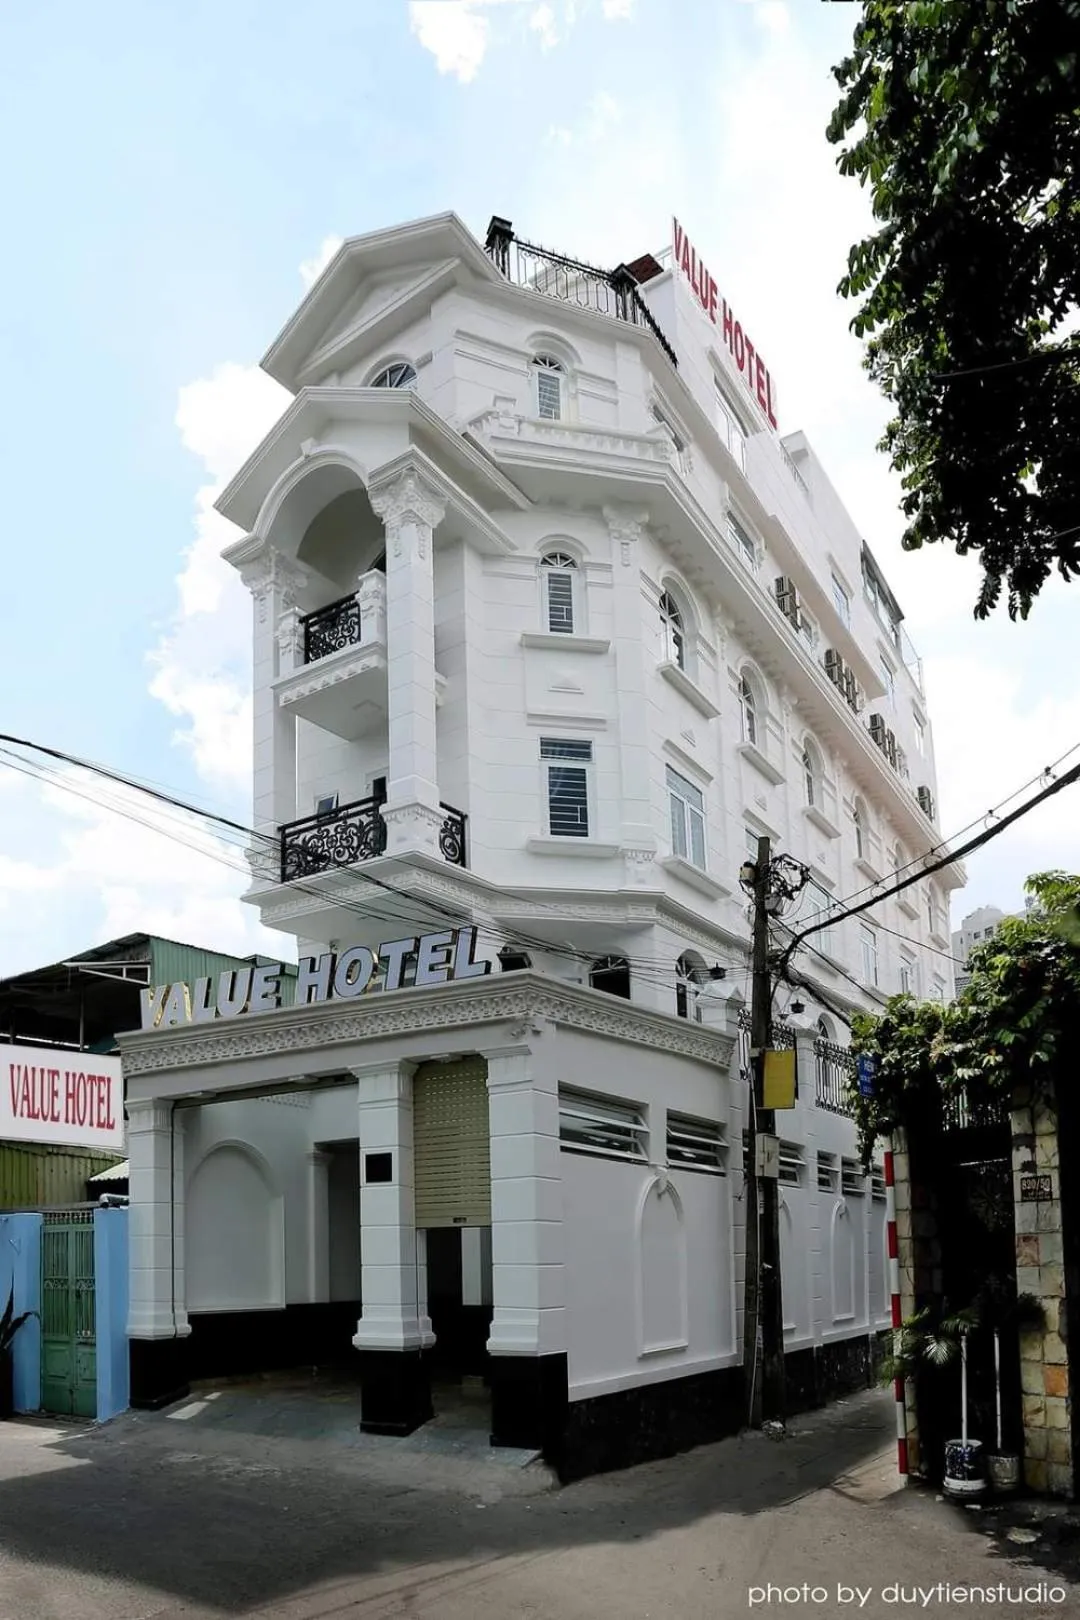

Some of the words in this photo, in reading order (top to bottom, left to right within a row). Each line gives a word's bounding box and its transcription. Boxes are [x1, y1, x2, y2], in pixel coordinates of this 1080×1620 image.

[672, 215, 718, 325] VALUE
[722, 297, 777, 431] HOTEL
[139, 963, 285, 1030] VALUE
[299, 925, 492, 1004] HOTEL
[9, 1063, 60, 1122] VALUE
[64, 1071, 116, 1130] HOTEL
